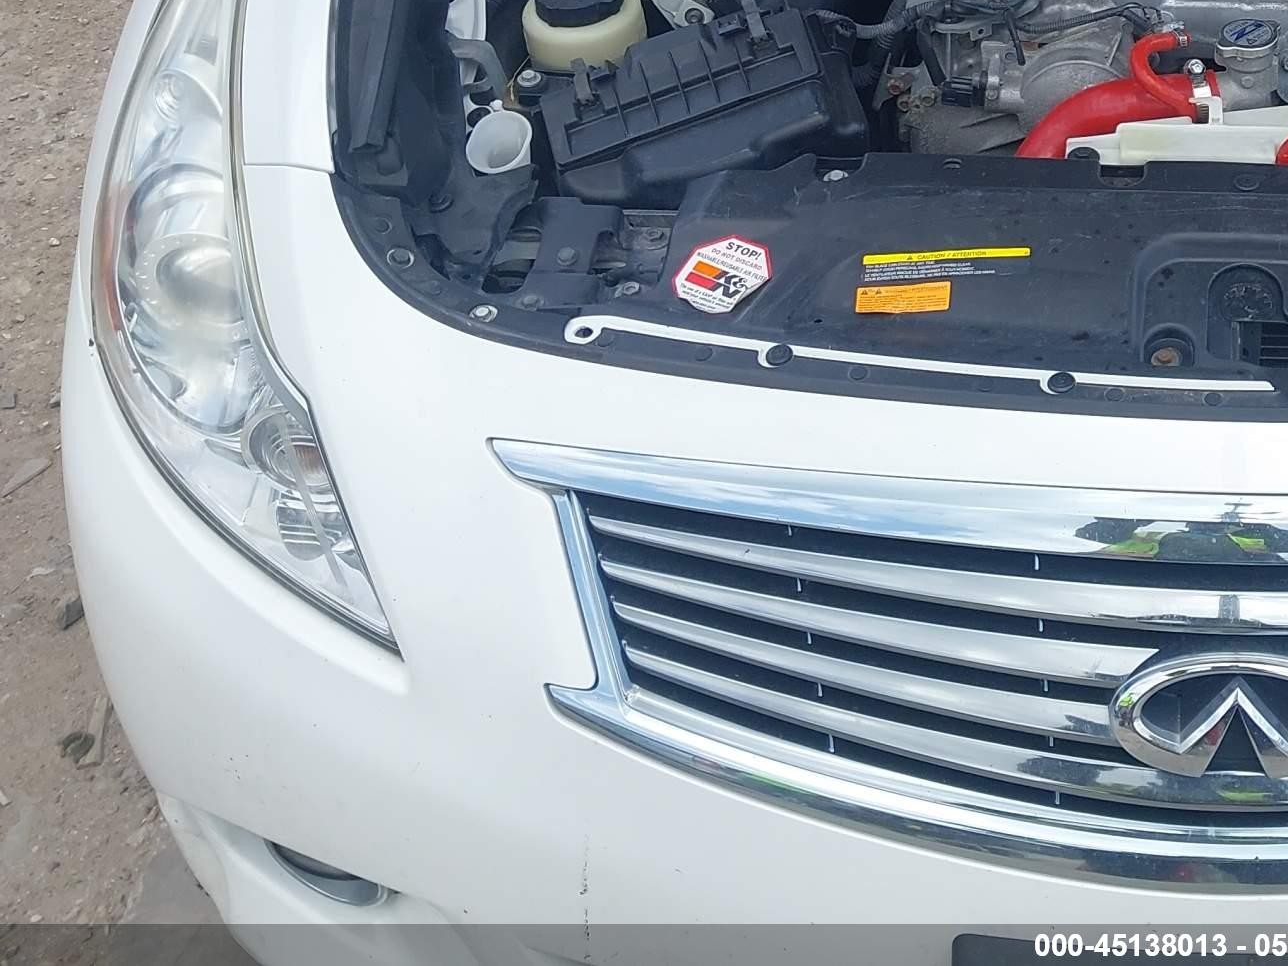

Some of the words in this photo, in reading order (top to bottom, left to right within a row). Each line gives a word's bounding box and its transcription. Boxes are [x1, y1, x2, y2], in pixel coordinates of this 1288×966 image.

[721, 251, 736, 261] NOT
[735, 256, 763, 270] DISCARD
[725, 241, 762, 261] STOP!
[951, 250, 987, 258] ATTENTION
